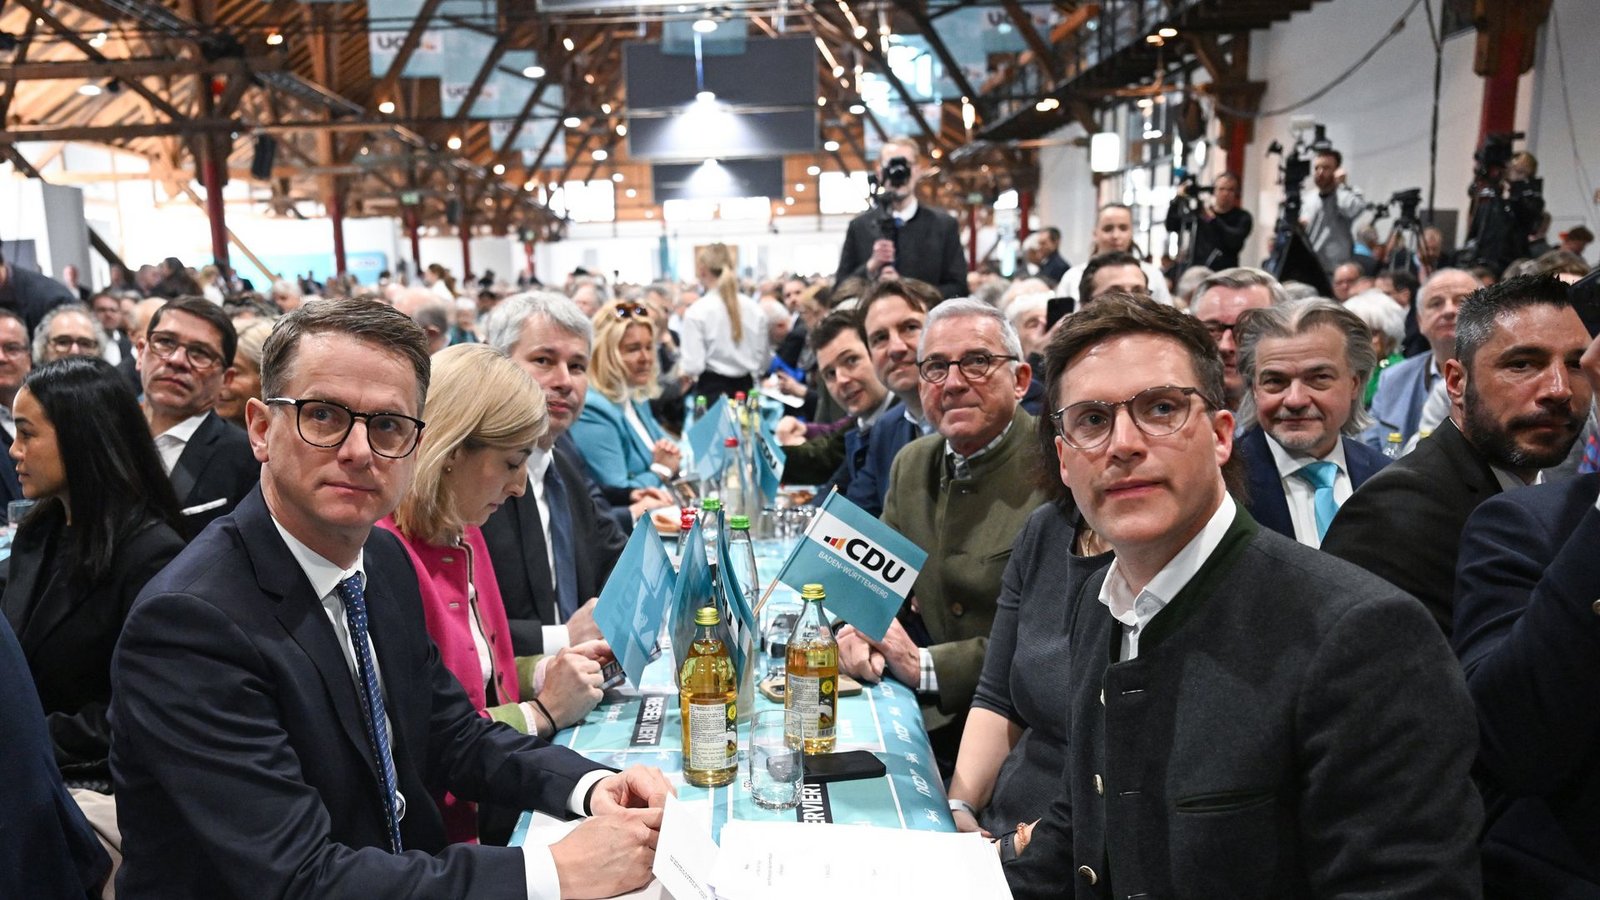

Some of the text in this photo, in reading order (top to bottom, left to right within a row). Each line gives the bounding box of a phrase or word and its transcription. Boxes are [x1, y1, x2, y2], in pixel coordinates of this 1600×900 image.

[818, 551, 889, 599] BADEN-WÜRTTEMBERG
[846, 538, 906, 583] CDU
[802, 784, 825, 824] ERVIERT
[911, 775, 932, 798] CDU
